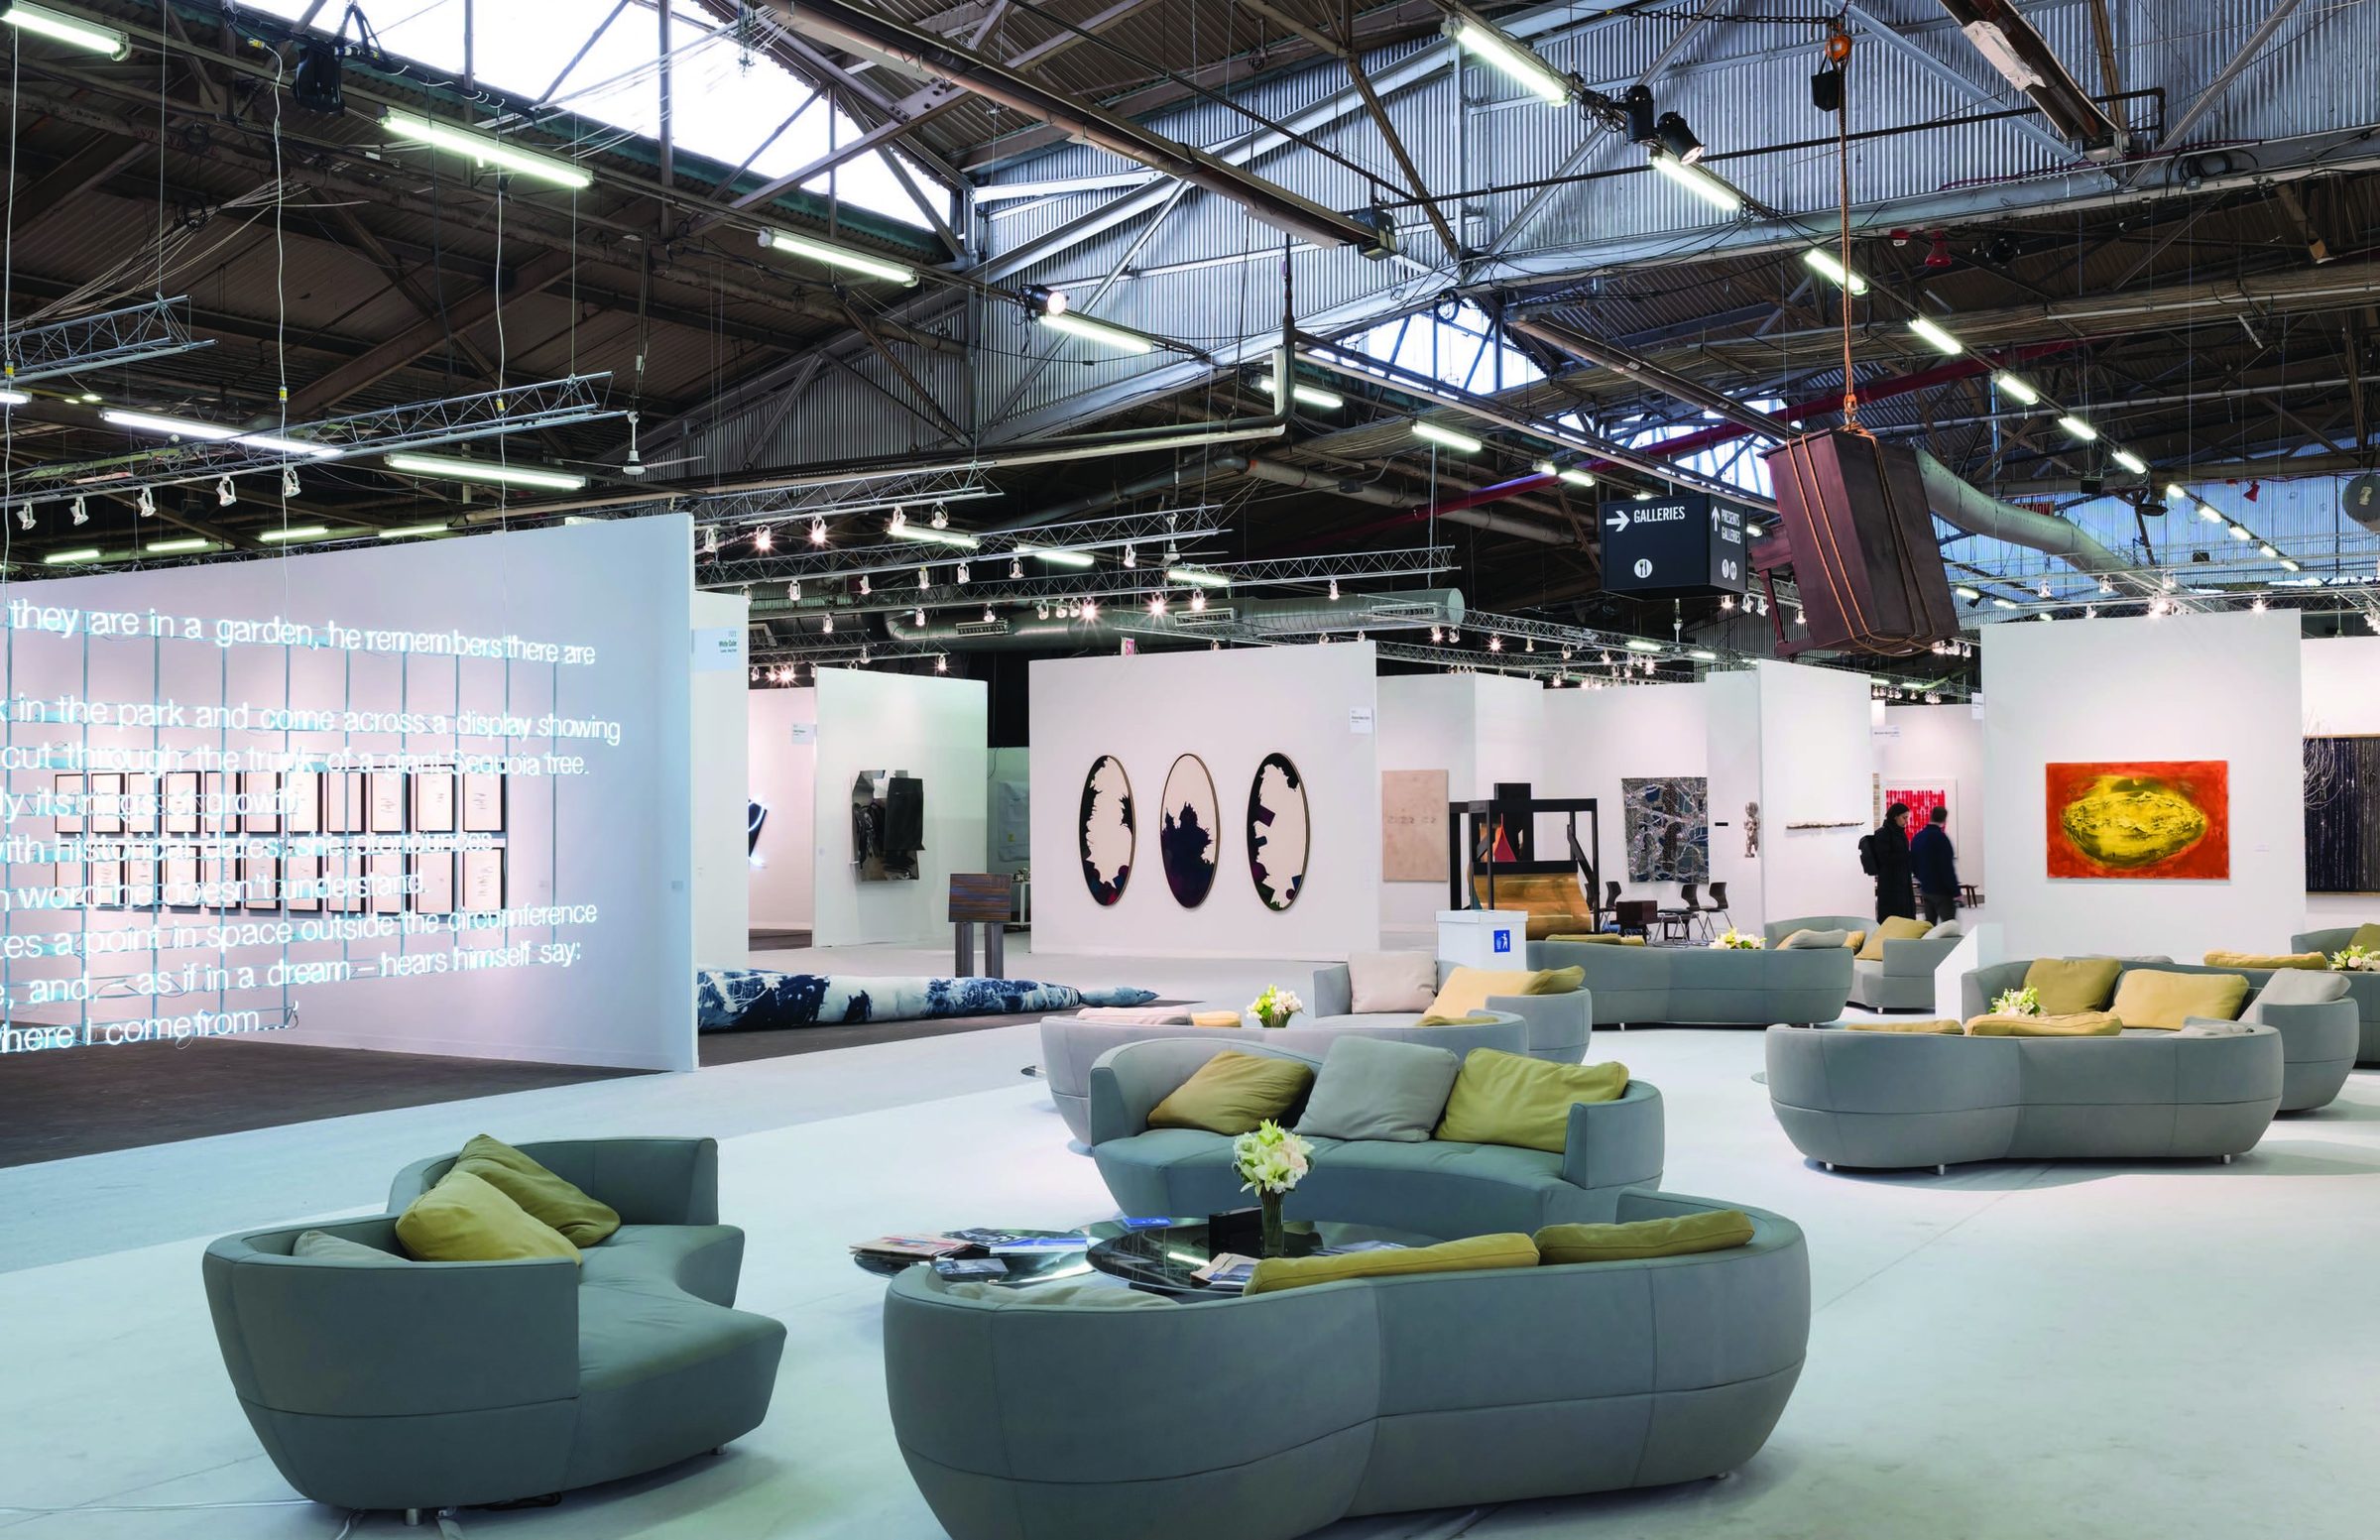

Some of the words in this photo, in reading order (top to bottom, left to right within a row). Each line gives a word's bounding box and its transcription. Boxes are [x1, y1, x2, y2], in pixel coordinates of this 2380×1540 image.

[1633, 506, 1686, 524] GALLERIES
[1721, 530, 1741, 544] GALLERIES
[11, 598, 78, 639] they
[90, 611, 140, 635] are
[149, 608, 175, 637] in
[184, 617, 203, 640] a
[215, 616, 318, 651] garden,
[328, 620, 361, 650] he
[365, 629, 502, 658] remembers
[503, 635, 558, 662] there
[564, 645, 596, 664] are
[19, 692, 46, 722] in
[56, 694, 107, 724] the
[116, 698, 185, 735] park
[195, 702, 249, 730] and
[259, 709, 334, 731] come
[342, 709, 427, 735] across
[431, 714, 448, 735] a
[456, 710, 532, 741] display
[536, 712, 621, 746] showing
[0, 742, 51, 770] cut
[63, 742, 183, 779] through
[194, 745, 240, 770] the
[326, 746, 352, 772] of
[358, 753, 374, 772] a
[383, 750, 442, 779] giant
[447, 749, 540, 777] Sequoia
[544, 752, 590, 775] tree.
[35, 785, 71, 817] its
[0, 833, 45, 864] ith
[56, 832, 189, 863] historical
[296, 831, 342, 857] she
[352, 831, 494, 860] pronounces
[18, 879, 101, 908] word
[112, 877, 154, 906] he
[54, 933, 74, 955] a
[85, 922, 161, 960] point
[174, 920, 196, 951] in
[207, 921, 293, 953] space
[300, 912, 395, 942] outside
[400, 908, 439, 934] the
[447, 902, 598, 932] circumference
[137, 971, 172, 995] as
[183, 963, 199, 992] if
[205, 963, 229, 992] in
[237, 966, 256, 989] a
[268, 958, 351, 987] dream
[380, 951, 448, 978] hears
[453, 940, 532, 970] himself
[0, 1022, 74, 1053] here
[105, 1014, 191, 1045] come
